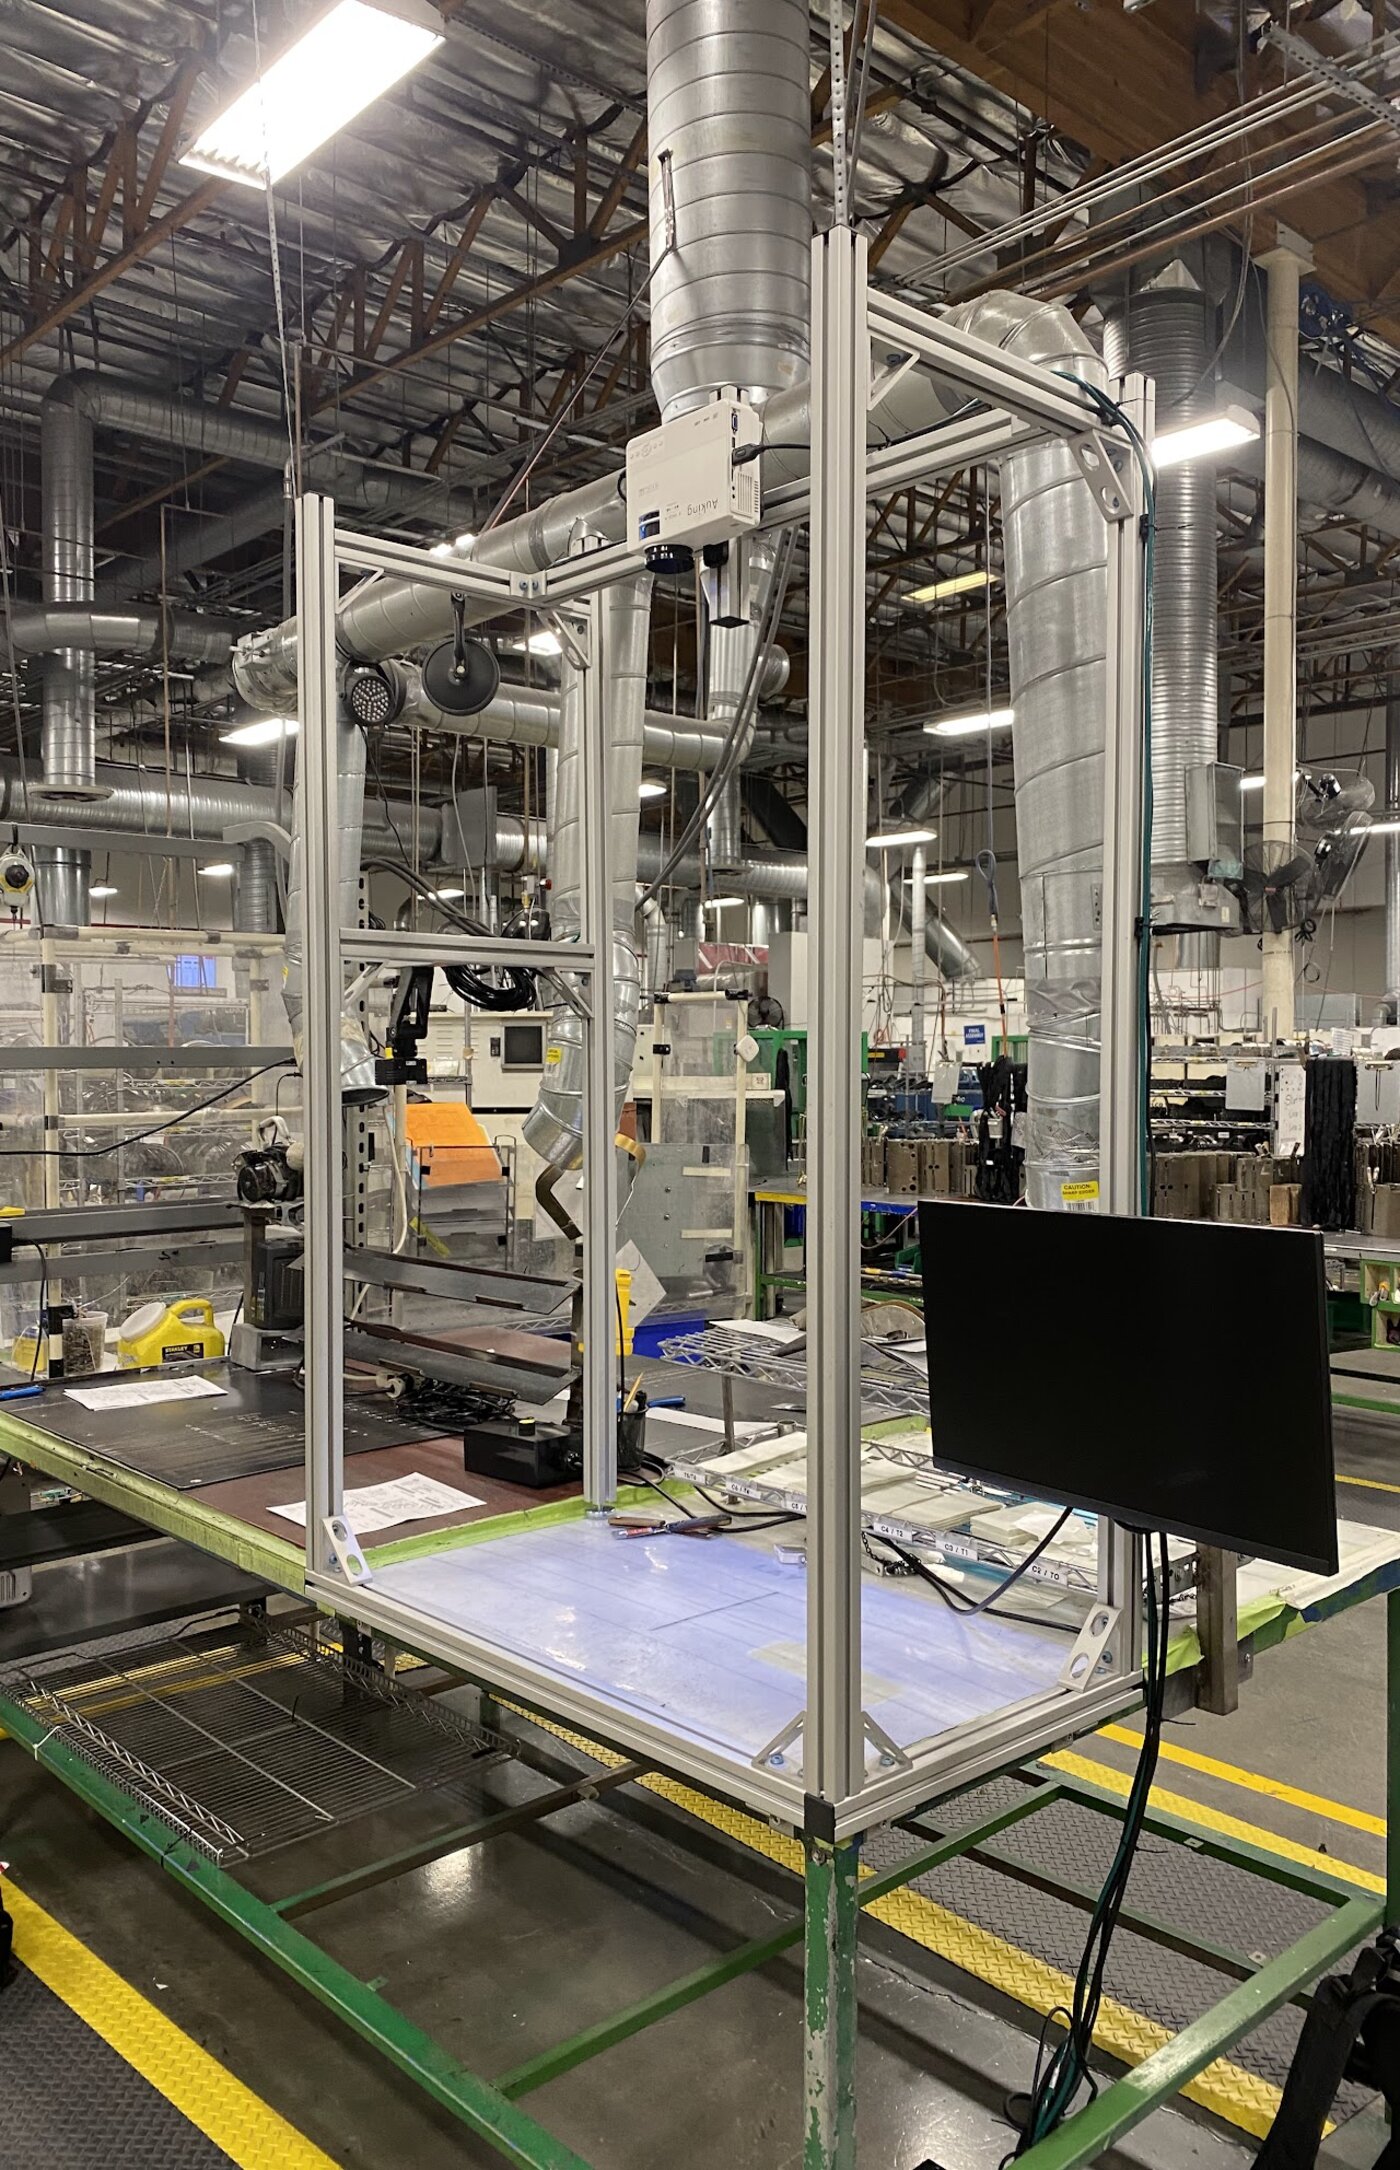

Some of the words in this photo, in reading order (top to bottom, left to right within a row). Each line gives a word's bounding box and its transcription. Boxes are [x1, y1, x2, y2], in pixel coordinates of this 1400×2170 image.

[688, 498, 718, 516] Auking
[880, 1525, 889, 1533] C4
[895, 1529, 904, 1538] T2
[944, 1543, 954, 1552] C3
[961, 1548, 969, 1556] T1
[1031, 1565, 1042, 1574] C2
